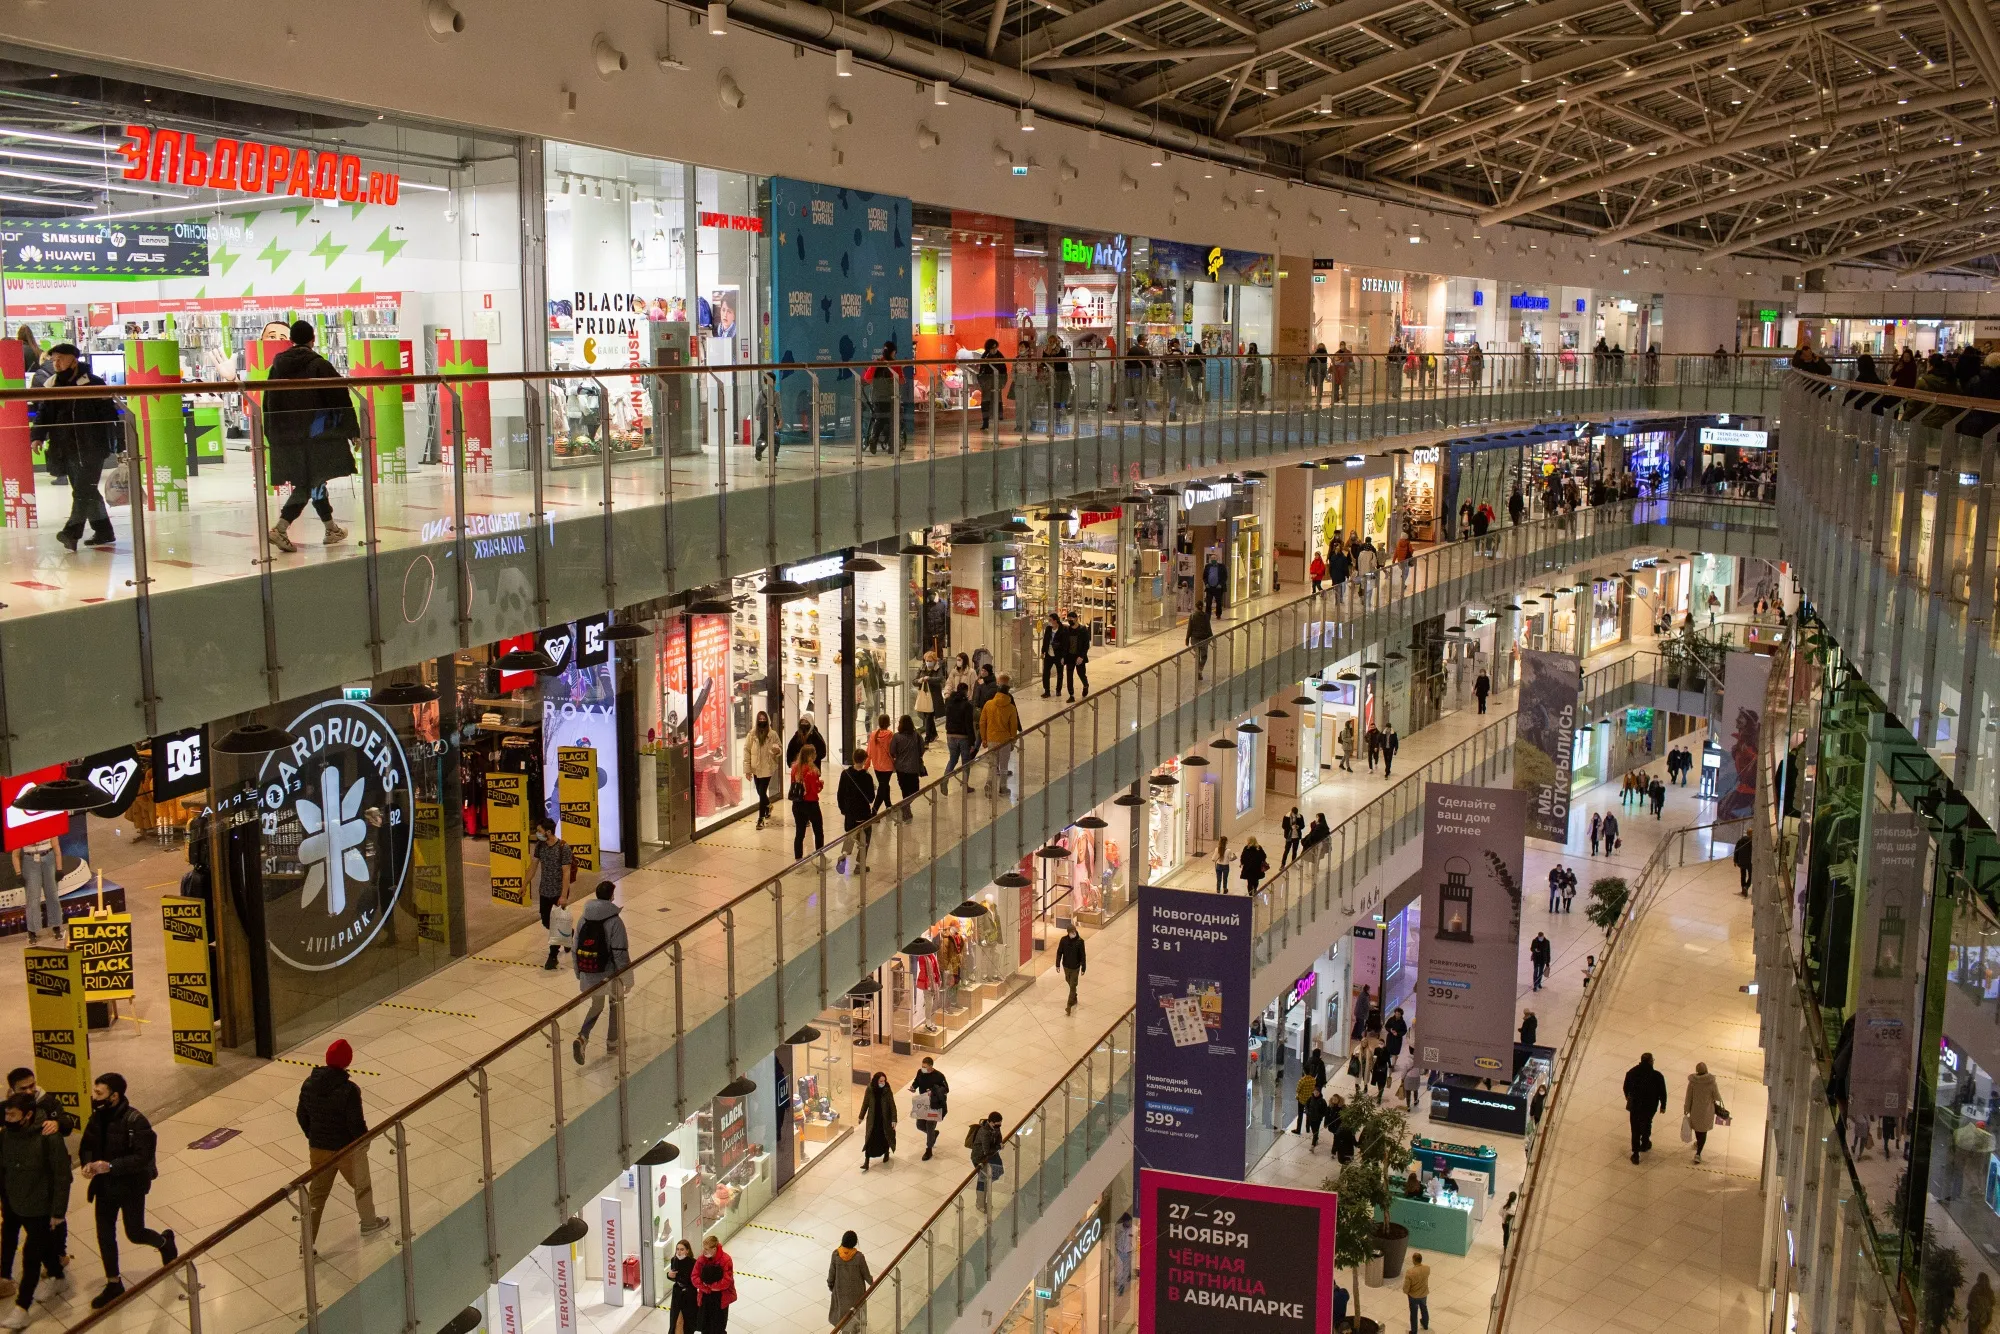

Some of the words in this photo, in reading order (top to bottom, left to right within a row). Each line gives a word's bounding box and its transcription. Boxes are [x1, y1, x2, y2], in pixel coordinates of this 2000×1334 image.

[732, 216, 763, 232] HOUSE
[42, 232, 103, 244] SAMSUNG
[141, 236, 167, 244] Lenovo
[45, 251, 96, 262] HUAWEI
[127, 252, 166, 263] ASUS
[1062, 238, 1094, 270] Baby
[1094, 242, 1113, 266] Art
[574, 292, 636, 312] BLACK
[575, 317, 636, 335] FRIDAY
[1414, 447, 1440, 464] crocs
[544, 701, 614, 724] ROXY
[558, 752, 588, 762] BLACK
[1553, 704, 1573, 818] ОТКРЫЛИСЬ
[559, 763, 588, 776] FRIDAY
[487, 779, 517, 788] BLACK
[488, 790, 518, 804] FRIDAY
[1438, 796, 1496, 811] Сделайте
[561, 802, 589, 812] BLACK
[390, 808, 401, 826] 92
[561, 814, 590, 827] FRIDAY
[1437, 810, 1462, 821] ваш
[1466, 812, 1491, 826] дом
[490, 832, 520, 842] BLACK
[1436, 824, 1482, 838] уютнее
[1544, 824, 1564, 836] этаж
[490, 843, 520, 858] FRIDAY
[572, 846, 590, 854] ACK
[492, 878, 521, 888] BLACK
[492, 888, 522, 903] FRIDAY
[164, 906, 199, 918] BLACK
[1152, 906, 1240, 926] Новогодний
[73, 926, 128, 939] BLACK
[164, 919, 201, 938] FRIDAY
[1152, 924, 1228, 942] календарь
[74, 938, 128, 957] FRIDAY
[1152, 938, 1159, 950] 3
[1163, 942, 1172, 952] в
[1174, 941, 1181, 952] 1
[26, 958, 66, 970] BLACK
[28, 972, 68, 990] FRIDAY
[85, 974, 130, 990] RIDAY
[169, 975, 204, 986] BLACK
[170, 988, 206, 1006] FRIDAY
[1286, 971, 1316, 1010] re:Store
[1428, 986, 1453, 999] 399
[35, 1032, 72, 1044] BLACK
[174, 1032, 209, 1042] BLACK
[35, 1045, 75, 1065] FRIDAY
[174, 1044, 211, 1063] FRIDAY
[1476, 1058, 1500, 1068] IKEA
[1146, 1074, 1188, 1086] Новогодний
[1146, 1083, 1183, 1092] календарь
[1184, 1088, 1202, 1096] ИКЕА
[55, 1094, 77, 1106] ACK
[1461, 1098, 1516, 1110] PIQUADRO
[721, 1102, 744, 1132] BLACK
[1146, 1110, 1174, 1126] 599
[1169, 1204, 1190, 1220] 27
[1213, 1209, 1236, 1227] 29
[1168, 1222, 1249, 1249] НОЯБРЯ
[608, 1218, 617, 1288] TERVOLINA
[1053, 1217, 1102, 1292] MANGO
[1168, 1248, 1246, 1274] ЧЁРНАЯ
[1168, 1268, 1266, 1297] ПЯТНИЦА
[558, 1259, 569, 1330] TERVOLINA
[1168, 1286, 1180, 1300] В
[1184, 1288, 1304, 1320] АВИАПАРКЕ
